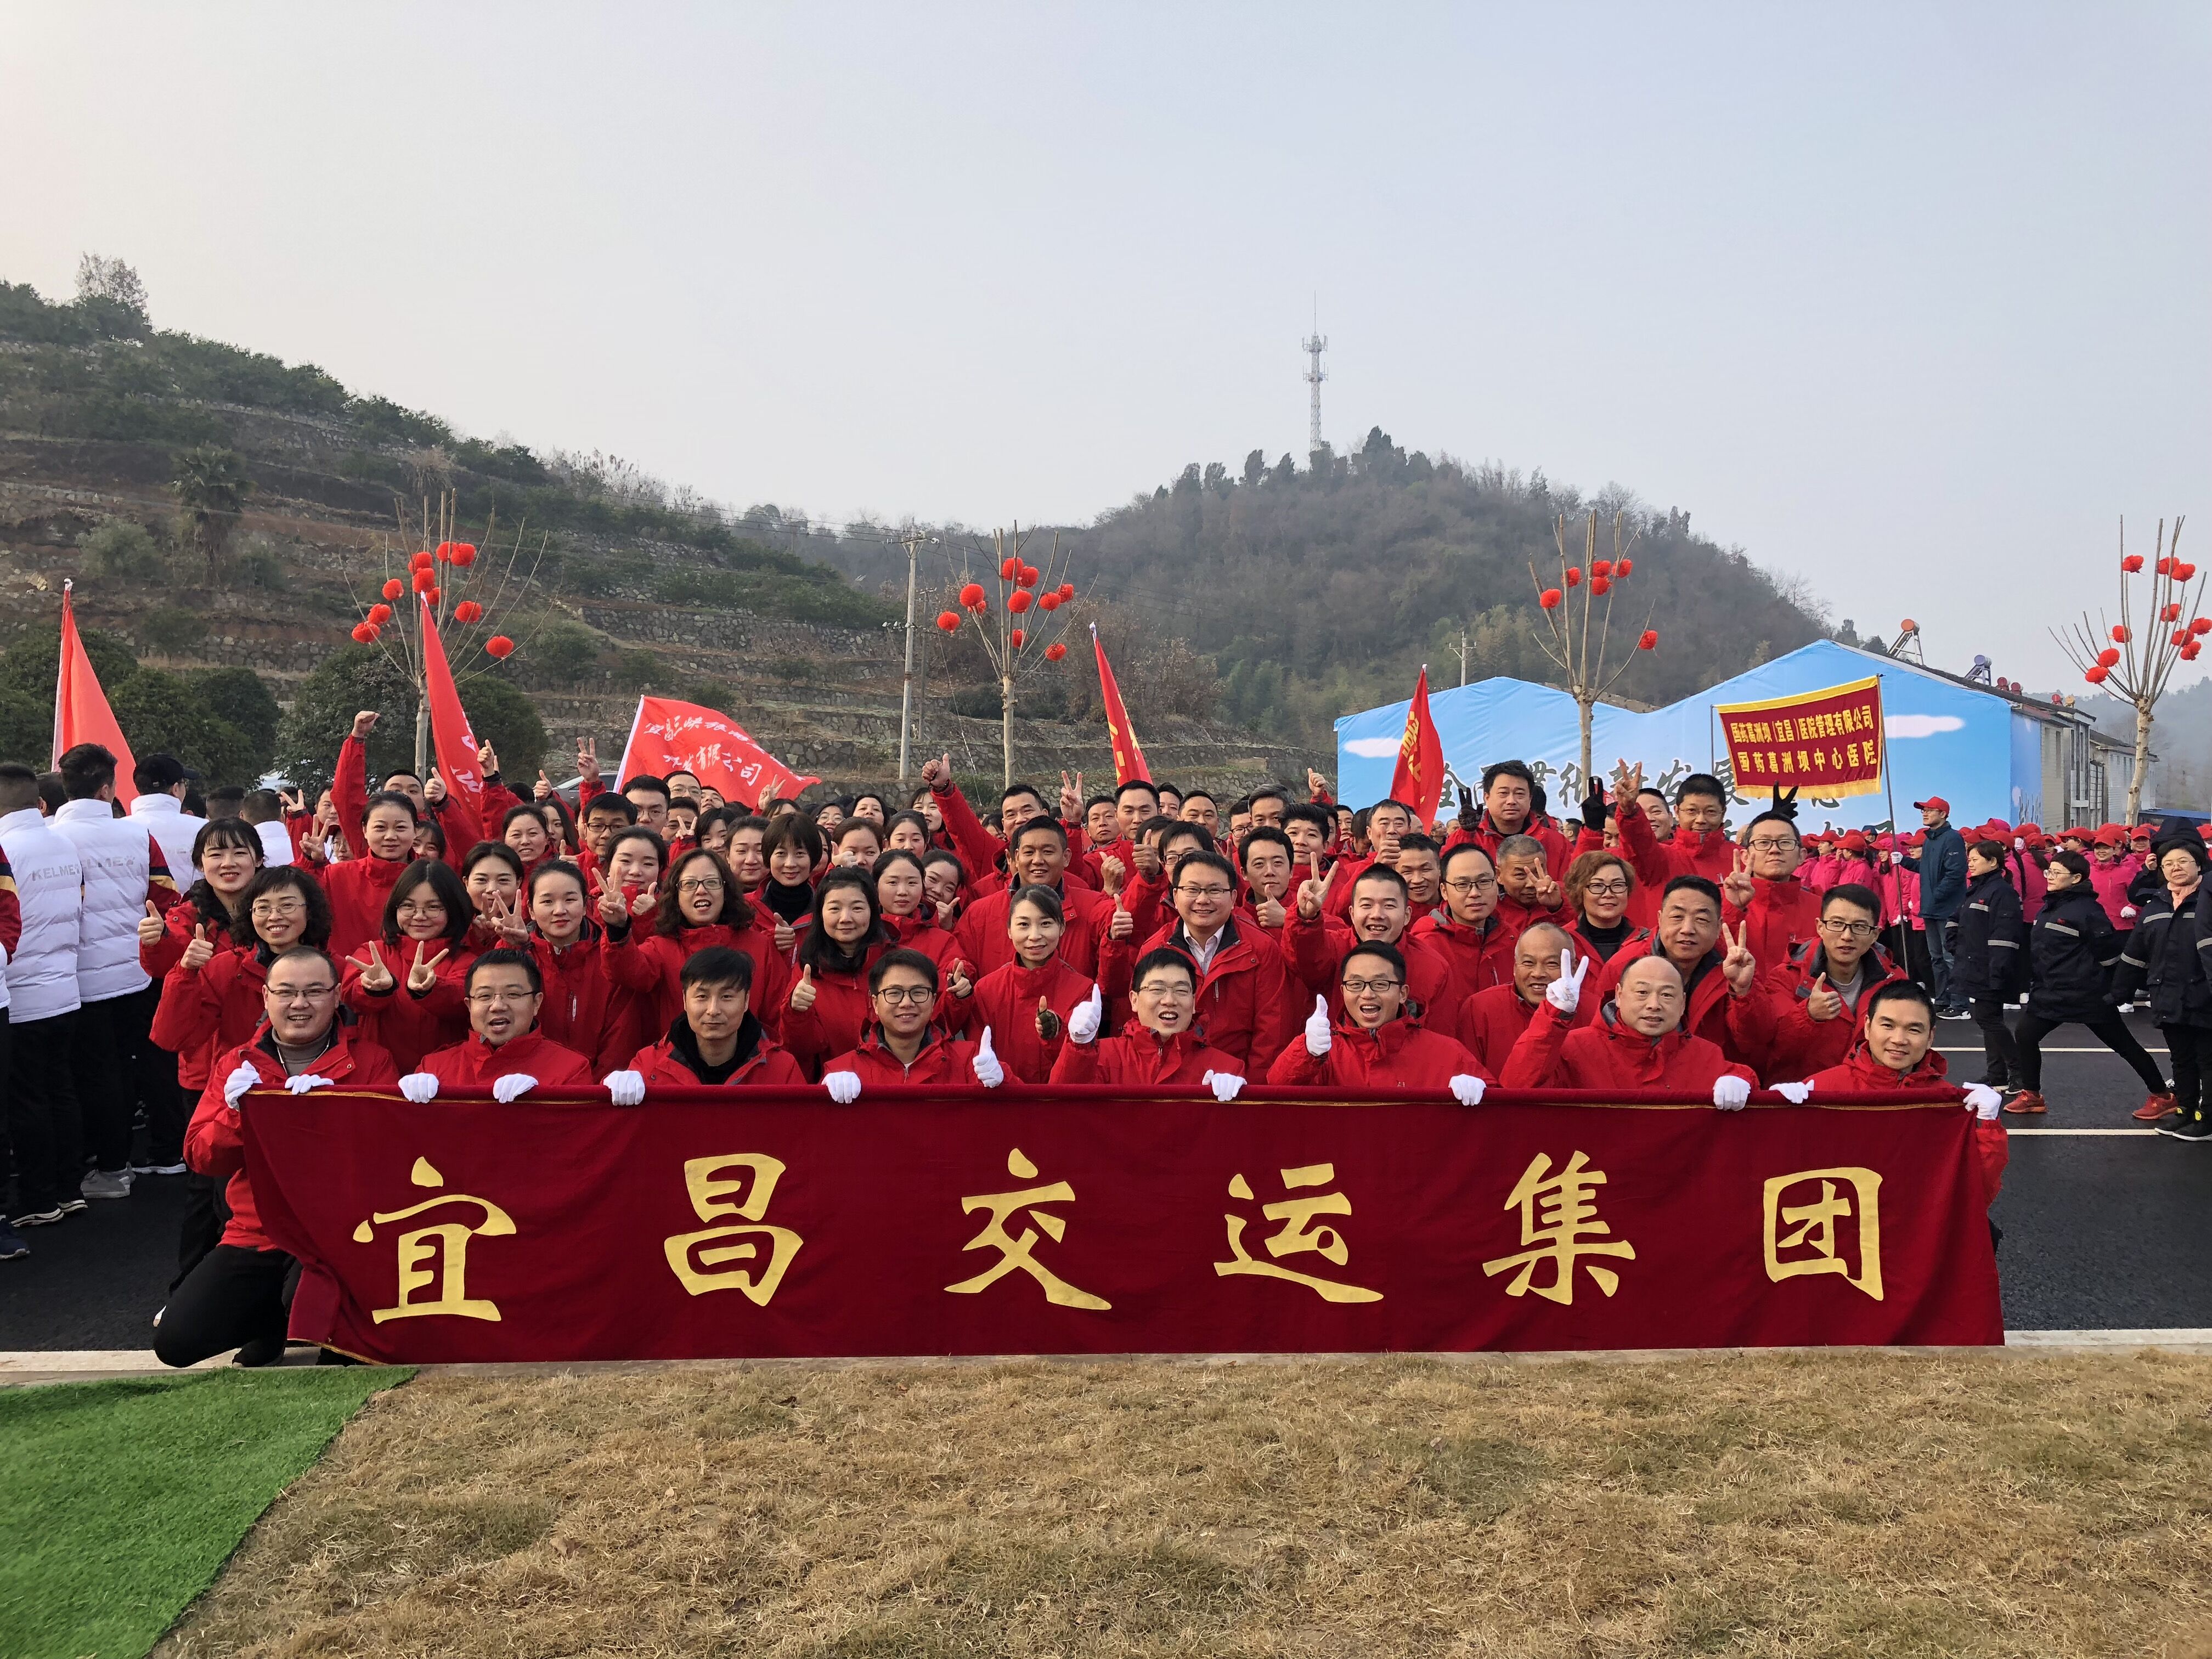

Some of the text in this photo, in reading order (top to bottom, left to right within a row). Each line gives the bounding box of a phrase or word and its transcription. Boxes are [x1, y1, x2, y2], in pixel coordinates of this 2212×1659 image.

[1737, 739, 1877, 774] 国药葛洲坝中心医院
[32, 863, 76, 881] KELME
[352, 1148, 1884, 1324] 宜昌交运集团
